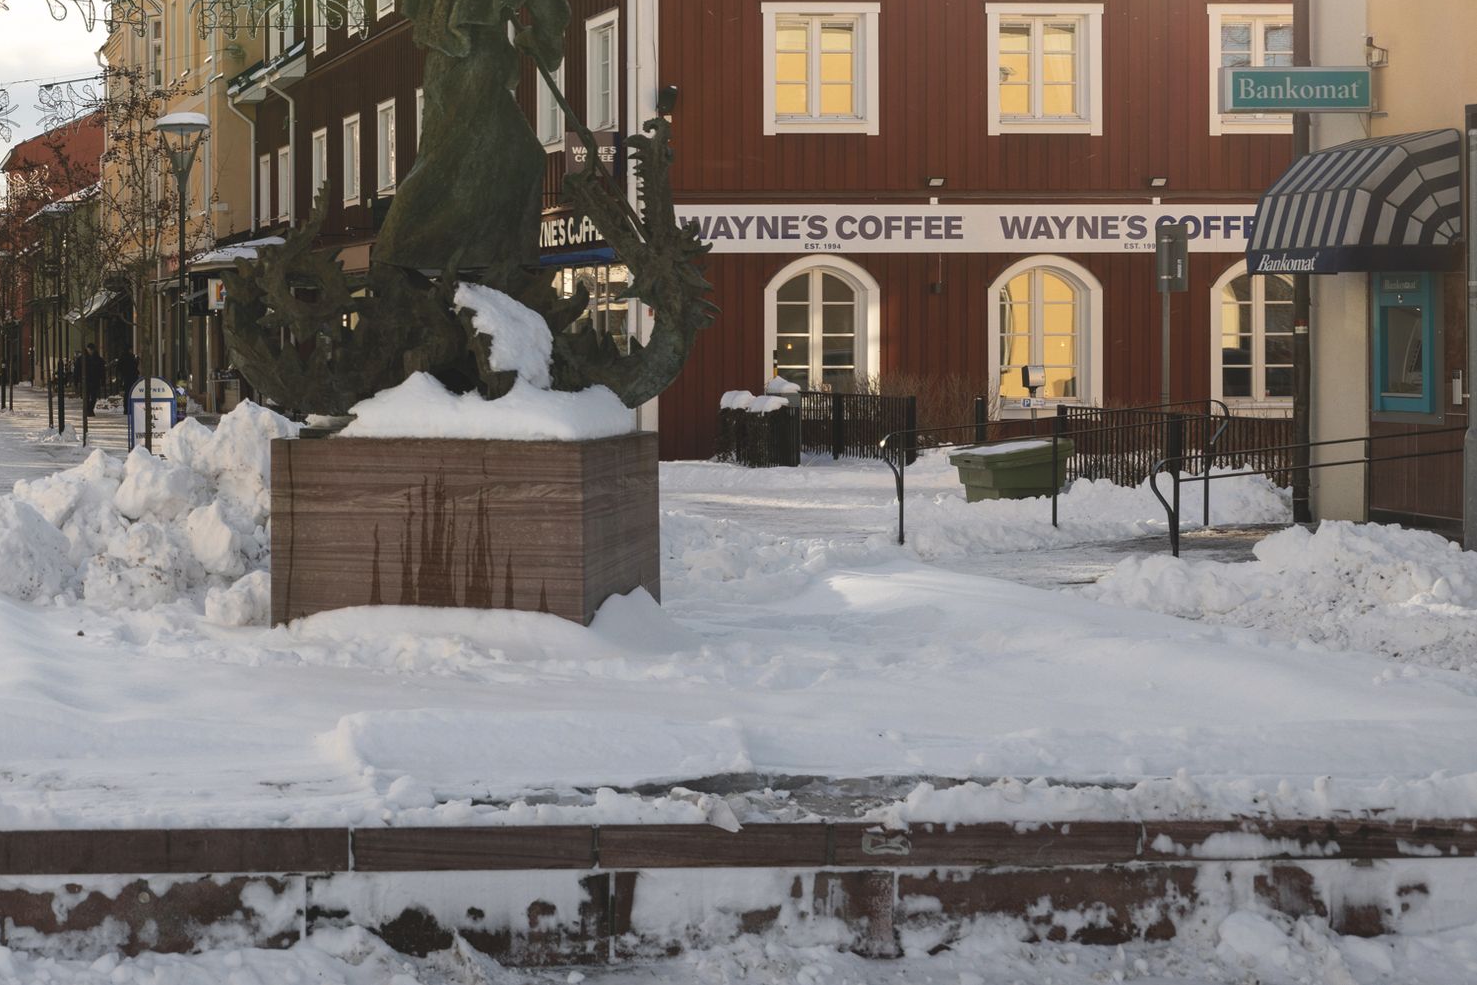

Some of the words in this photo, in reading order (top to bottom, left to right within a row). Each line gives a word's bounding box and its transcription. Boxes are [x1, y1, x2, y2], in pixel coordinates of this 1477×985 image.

[1238, 76, 1360, 99] Bankomat
[572, 146, 617, 155] WANE'S
[575, 154, 614, 162] COEE
[835, 215, 964, 241] COFFEE
[999, 214, 1147, 241] WAYNE'S
[1257, 253, 1317, 271] Bankomat
